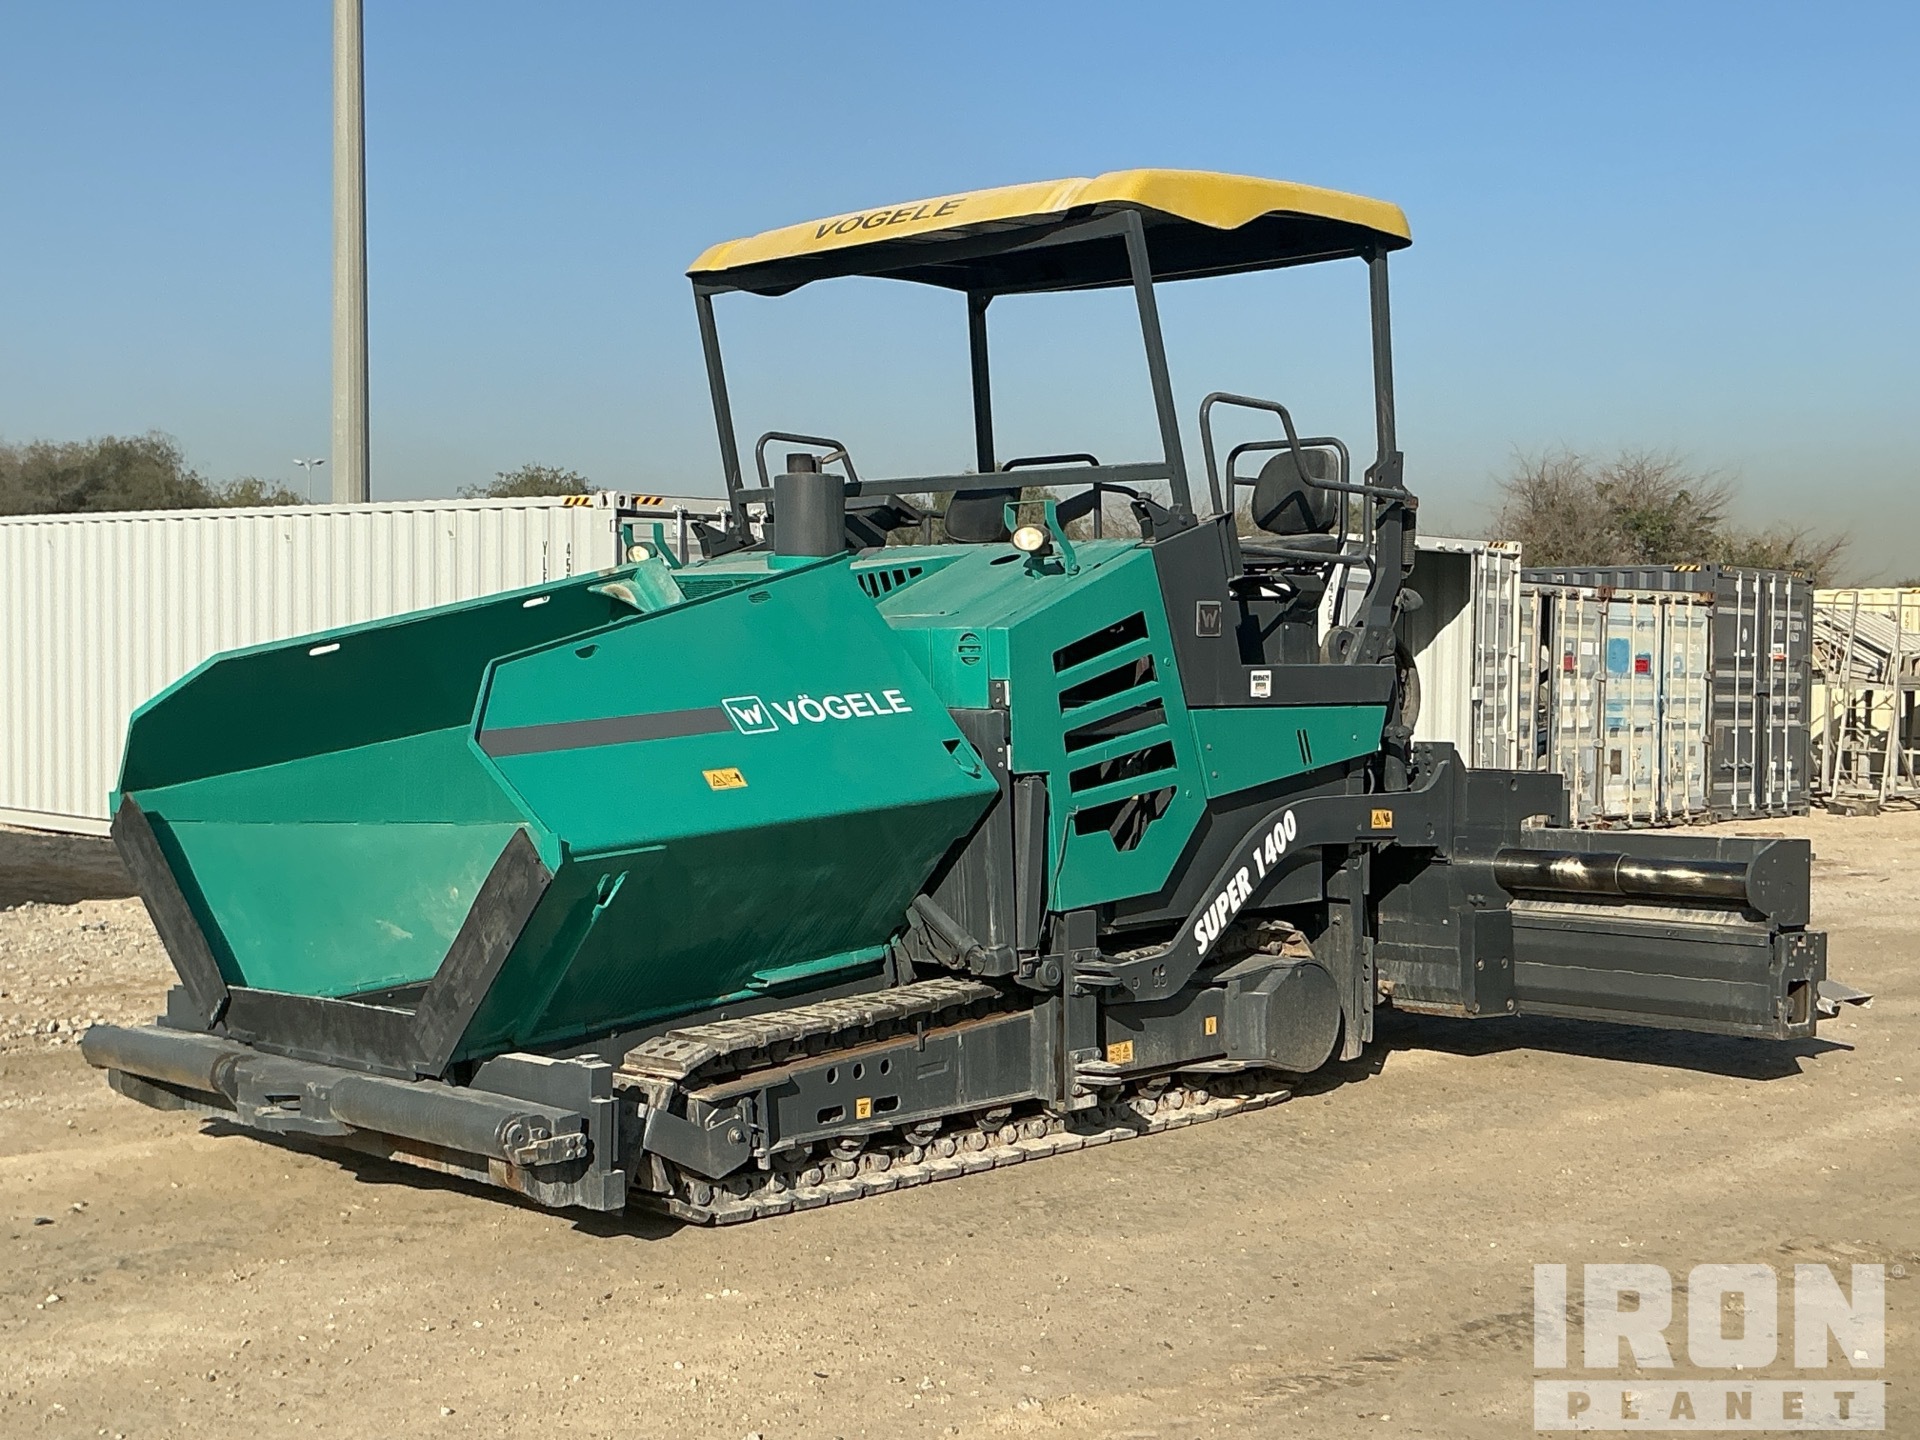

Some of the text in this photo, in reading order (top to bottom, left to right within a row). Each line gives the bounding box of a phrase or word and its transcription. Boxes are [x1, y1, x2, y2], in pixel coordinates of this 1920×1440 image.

[771, 689, 913, 725] VÖGELE
[1193, 809, 1297, 955] SUPER 1400
